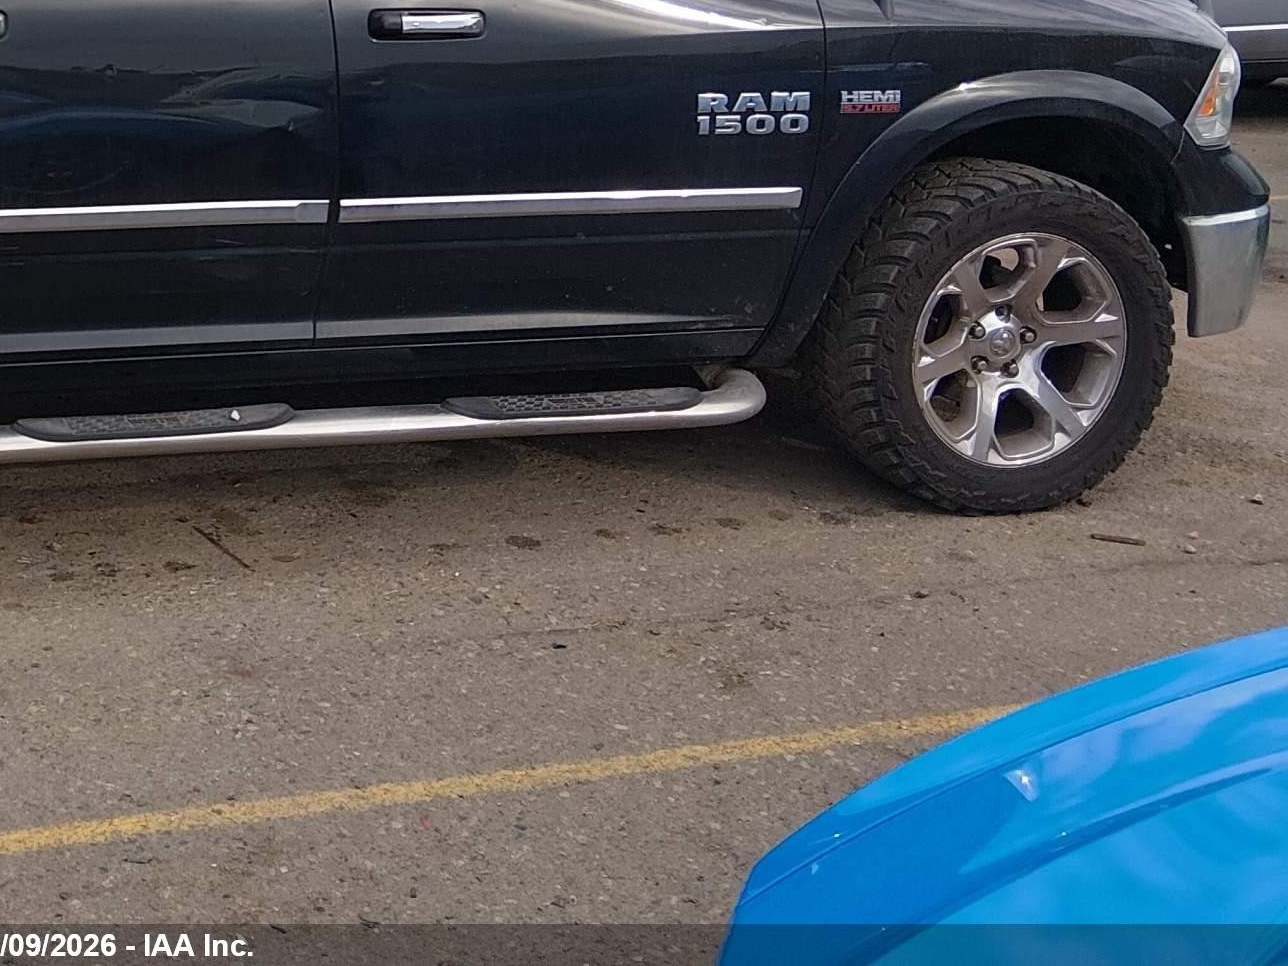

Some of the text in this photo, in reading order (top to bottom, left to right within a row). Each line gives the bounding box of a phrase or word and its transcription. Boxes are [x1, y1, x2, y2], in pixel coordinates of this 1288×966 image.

[697, 91, 811, 113] RAM
[840, 90, 901, 103] HEMI
[696, 113, 809, 135] 1500
